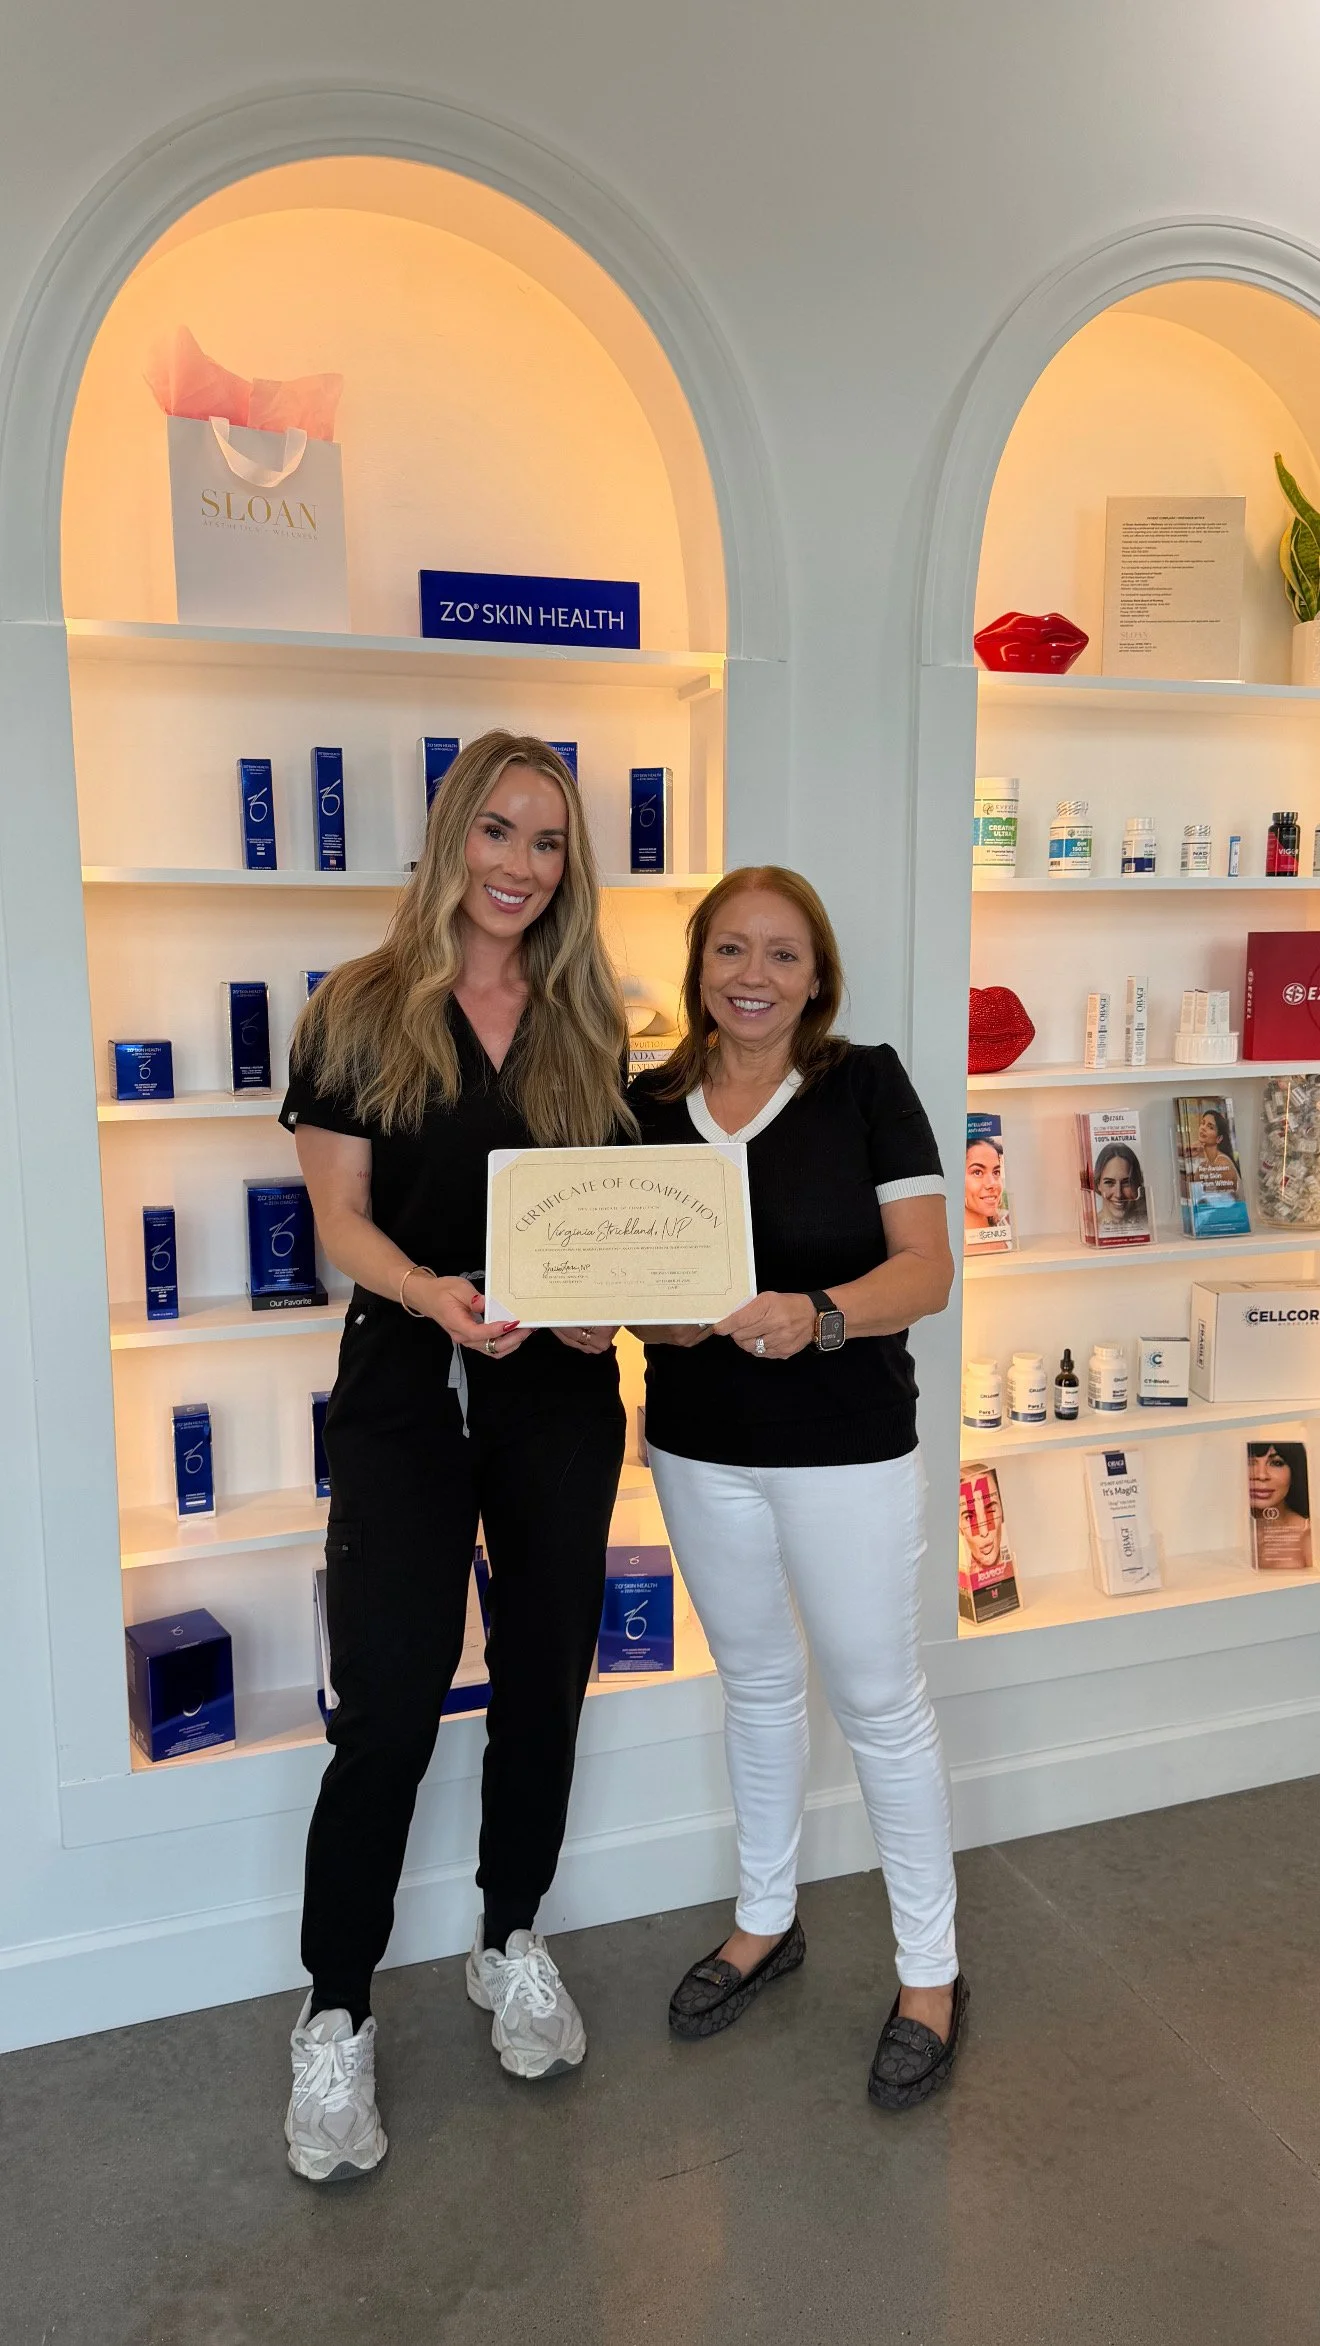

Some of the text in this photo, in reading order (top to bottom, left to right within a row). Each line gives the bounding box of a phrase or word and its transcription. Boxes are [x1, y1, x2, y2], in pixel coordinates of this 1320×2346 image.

[201, 488, 318, 531] SLOAN
[482, 603, 533, 626] SKIN
[539, 606, 625, 630] HEALTH
[630, 1052, 656, 1060] ADA
[515, 1177, 724, 1232] CERTIFICATE OF COMPLETION
[547, 1216, 693, 1247] Virginia Strickland, NP
[269, 1297, 312, 1307] Our Favorite
[1102, 1488, 1114, 1496] It's
